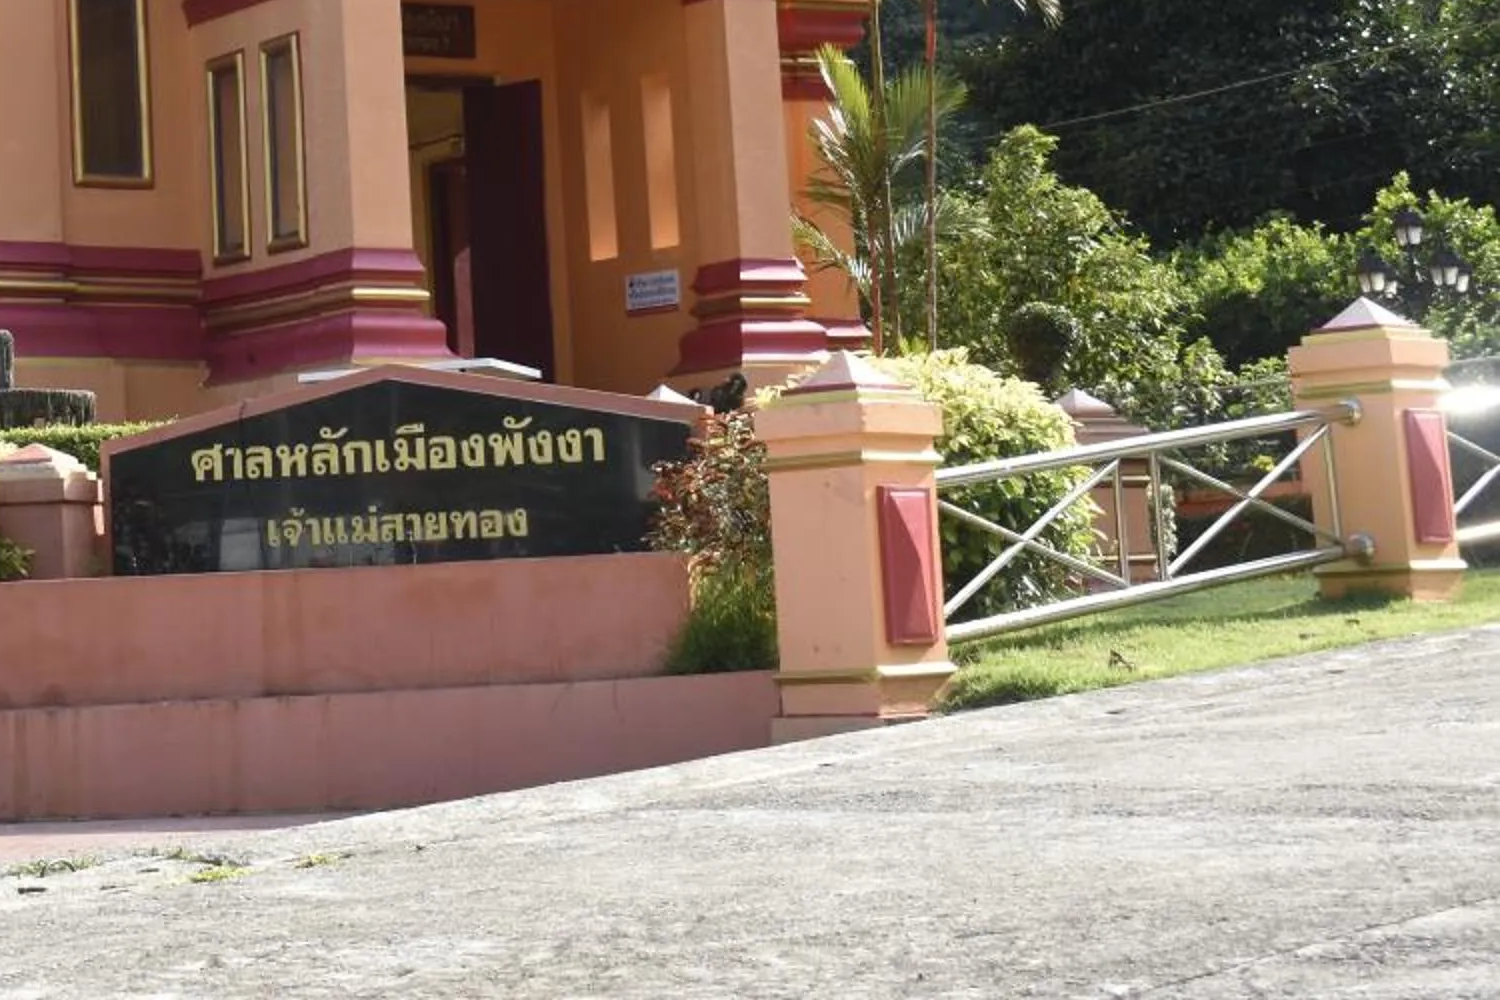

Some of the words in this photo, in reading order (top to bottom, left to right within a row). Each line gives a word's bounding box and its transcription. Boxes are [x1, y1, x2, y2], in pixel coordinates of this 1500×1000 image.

[191, 416, 605, 481] ศาลหลักเมืองพังงา
[267, 505, 528, 548] เจ้าแม่สายทอง
